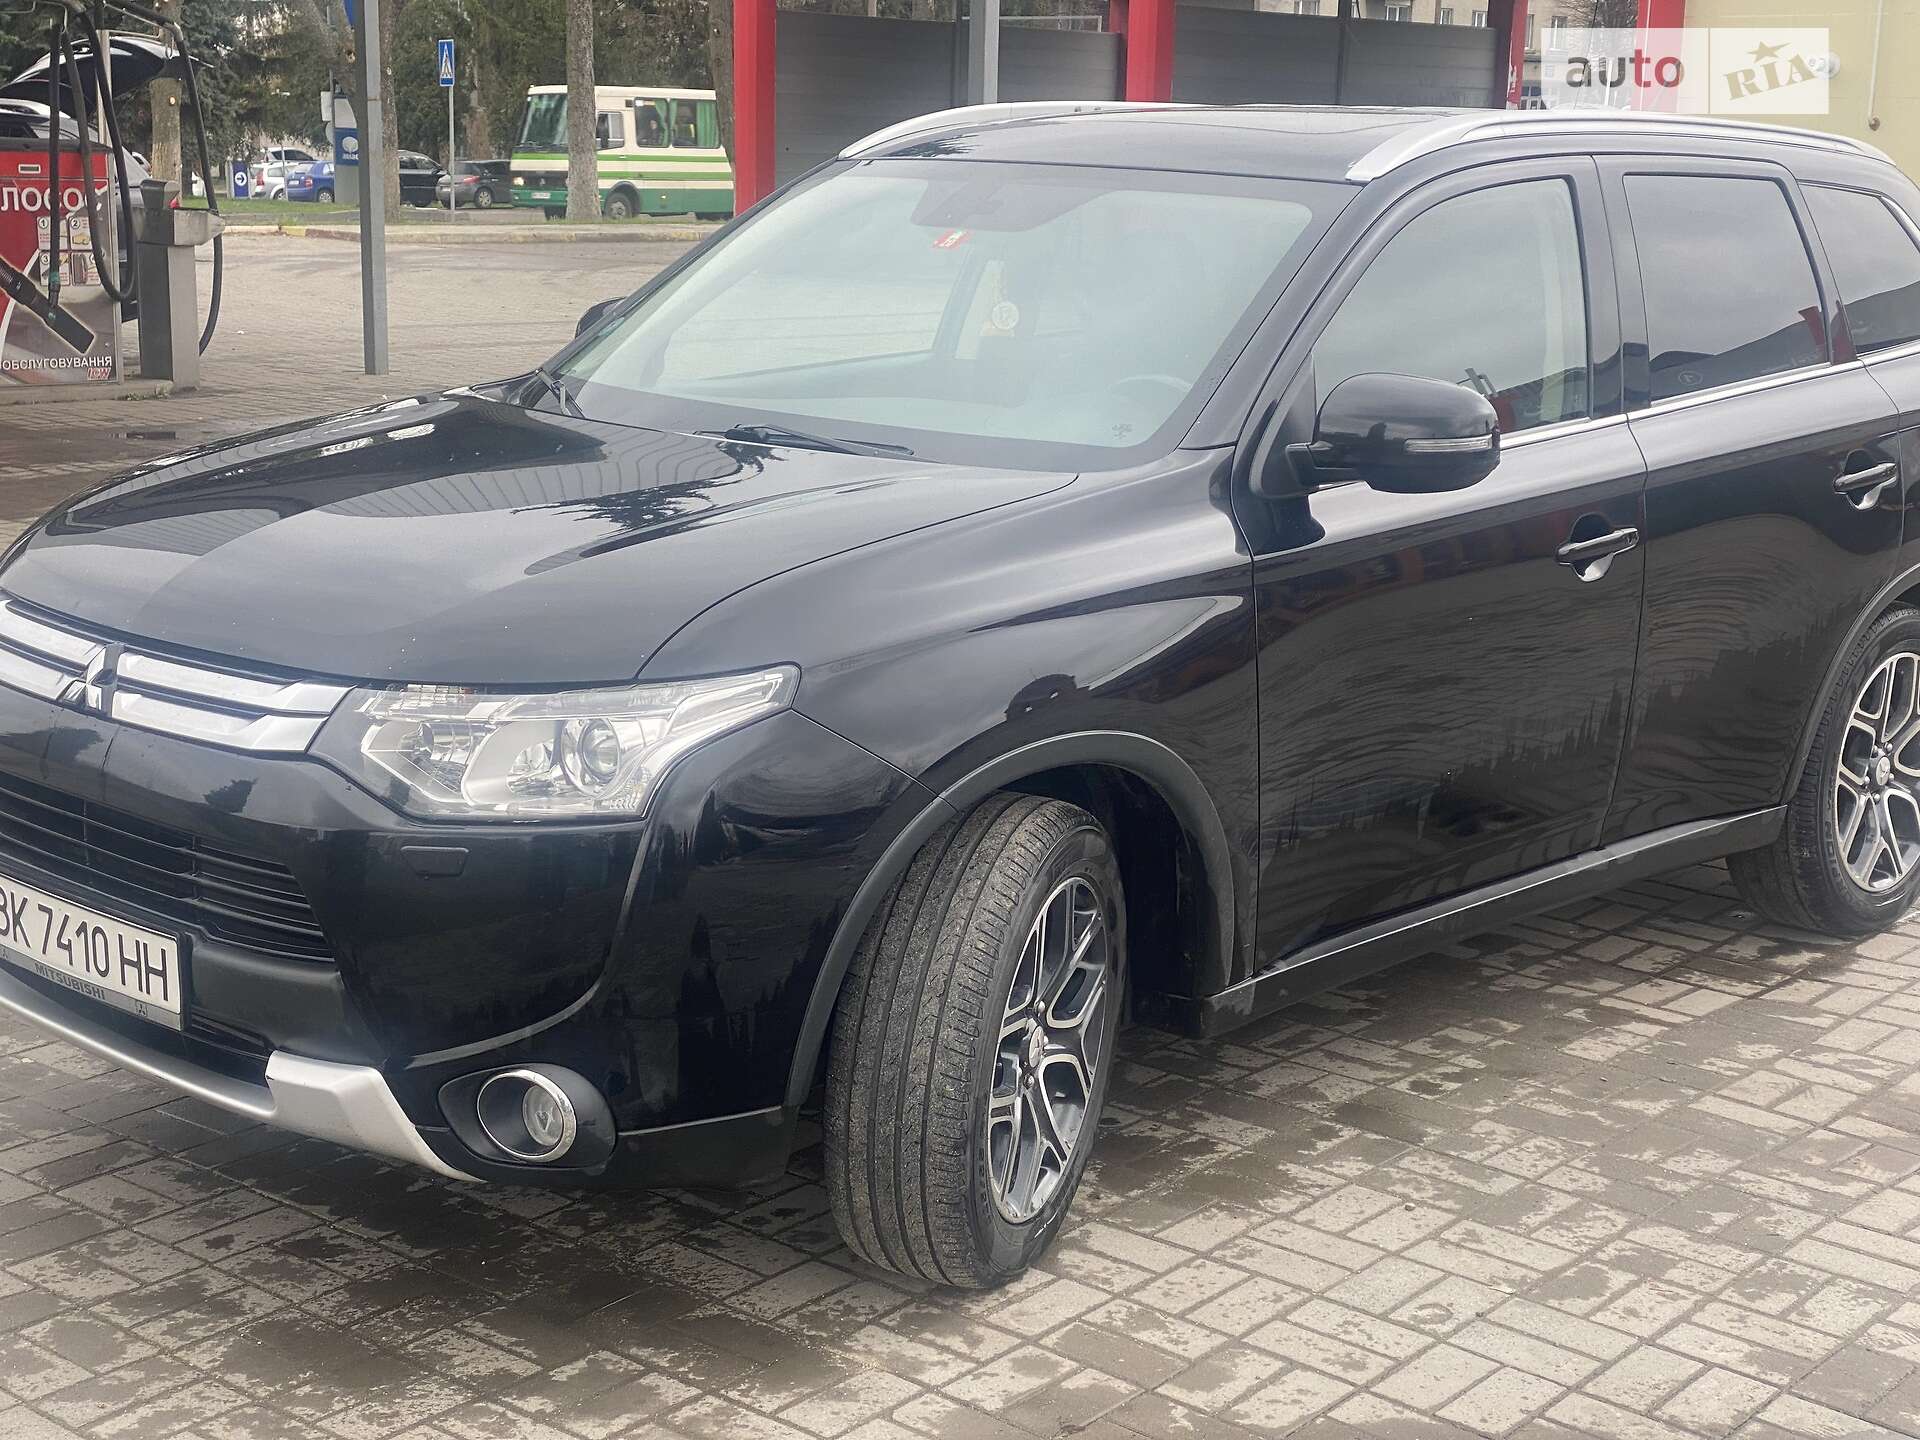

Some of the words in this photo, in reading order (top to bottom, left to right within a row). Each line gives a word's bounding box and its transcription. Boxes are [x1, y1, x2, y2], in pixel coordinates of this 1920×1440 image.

[2, 356, 112, 370] ОБСЛУГОВУВАННЯ
[37, 903, 110, 978] 7410
[117, 933, 169, 1002] HH
[34, 962, 106, 1000] MITSUBISHI
